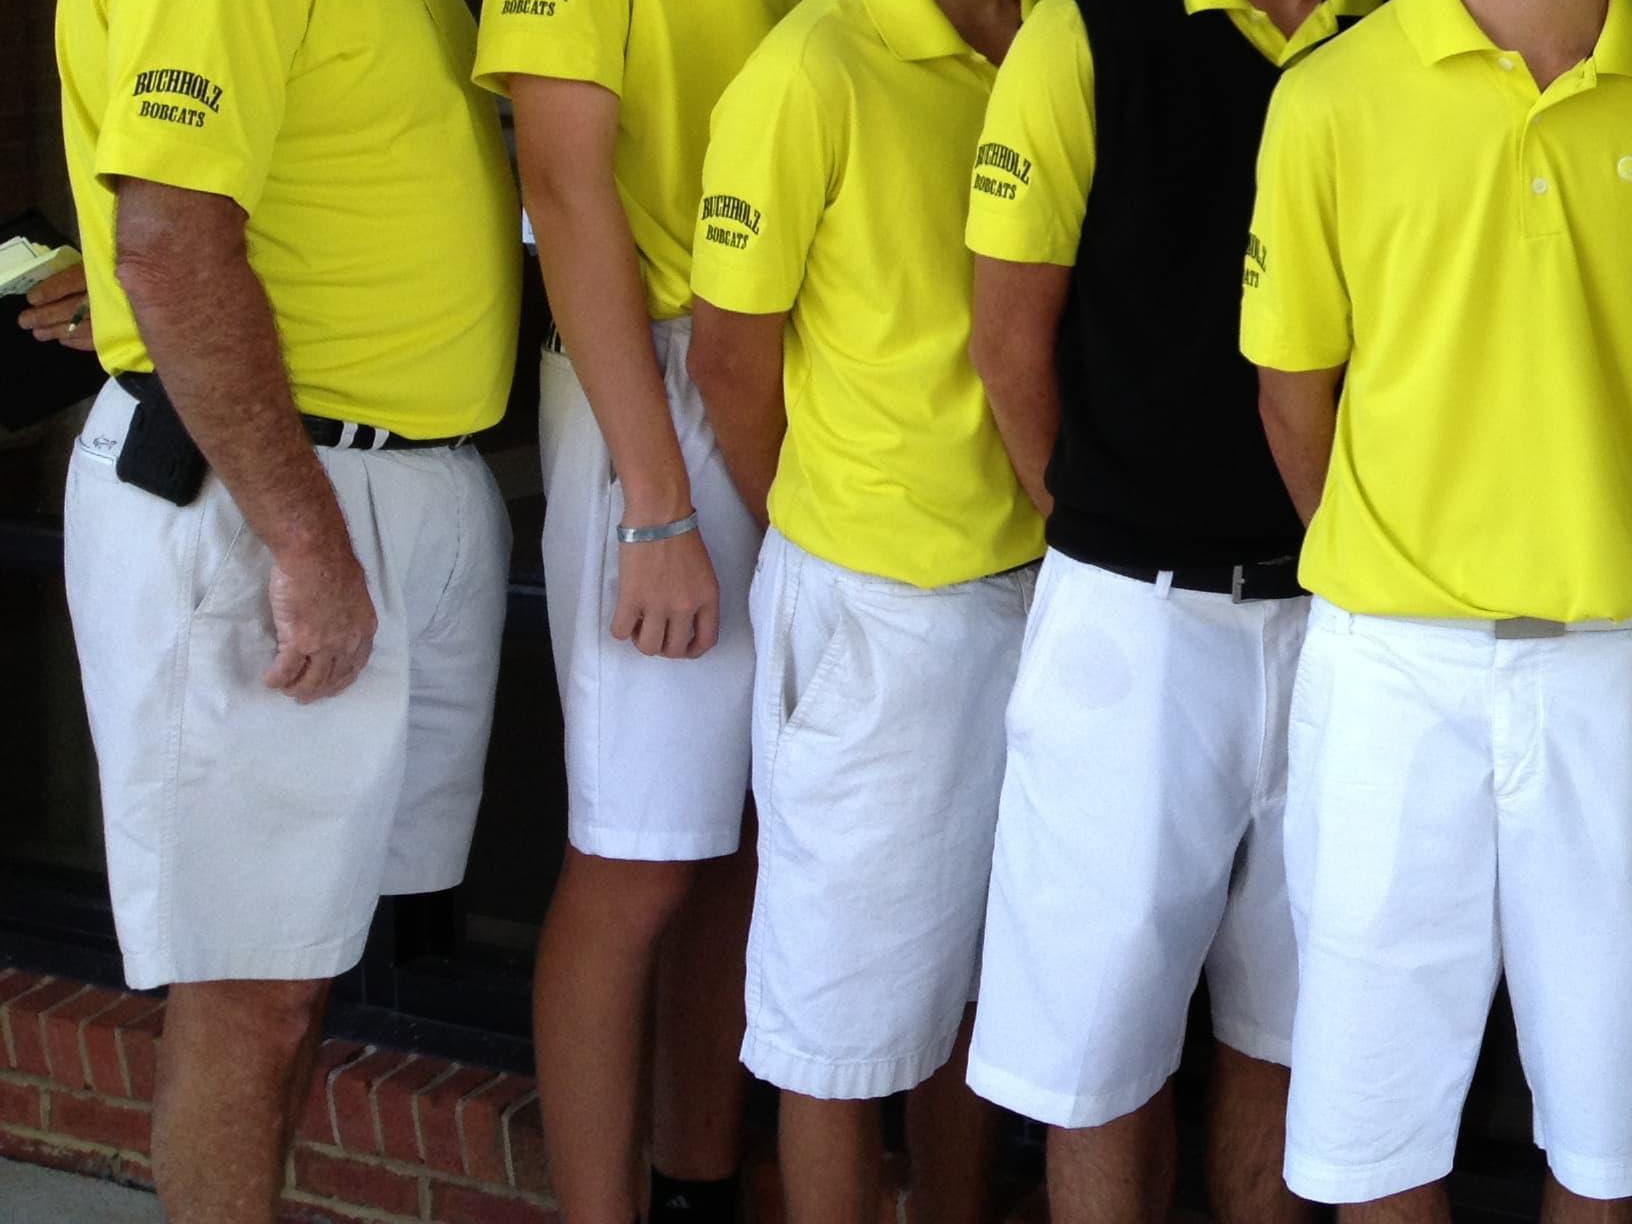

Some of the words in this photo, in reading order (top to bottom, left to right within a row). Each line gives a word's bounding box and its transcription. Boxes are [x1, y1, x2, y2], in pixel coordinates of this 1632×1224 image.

[503, 0, 555, 16] BOBCATS
[133, 69, 223, 113] BUCHHOLZ
[141, 101, 206, 127] BOBCATS
[702, 195, 761, 235] BUCHHOLZ
[706, 224, 748, 249] BOBCATS
